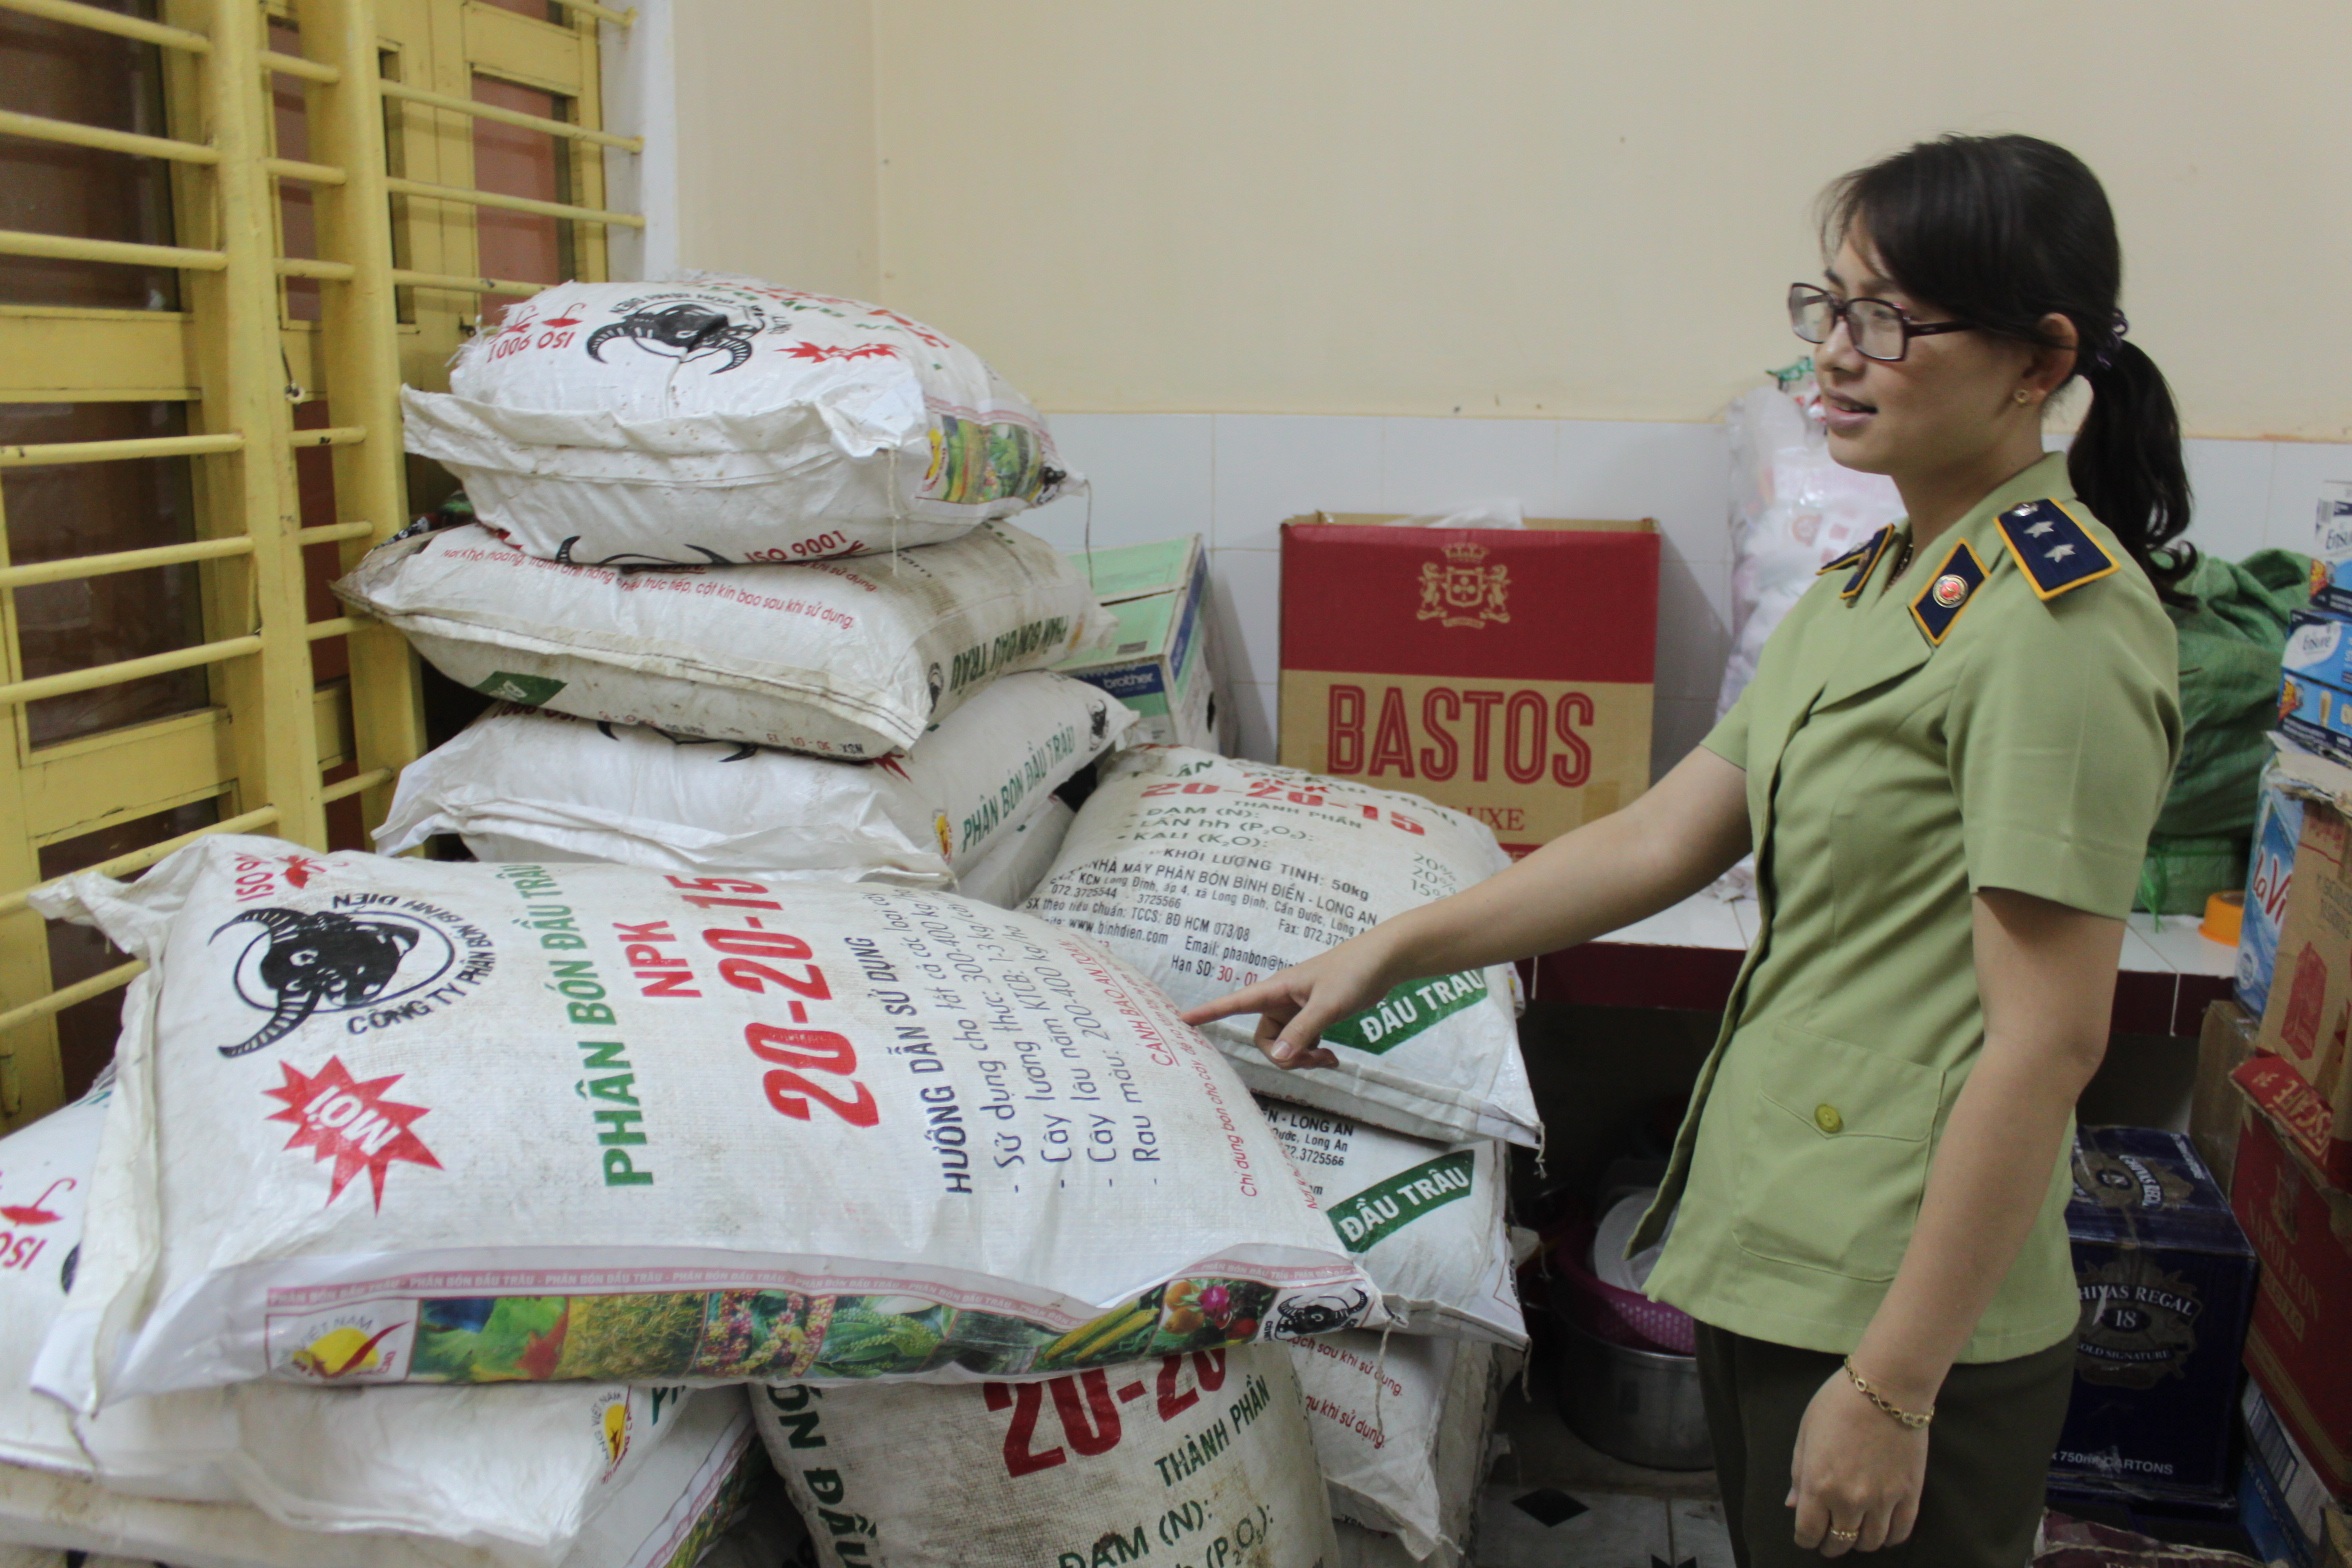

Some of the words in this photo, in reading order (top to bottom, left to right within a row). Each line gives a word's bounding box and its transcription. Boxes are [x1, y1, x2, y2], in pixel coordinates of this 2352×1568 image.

[485, 333, 532, 363] 9001
[538, 331, 576, 350] ISO
[790, 530, 849, 557] 9001
[736, 588, 762, 607] bao
[762, 596, 785, 611] sau
[786, 598, 805, 614] khi
[1103, 672, 1154, 690] brother
[1327, 684, 1595, 788] BASTOS
[960, 794, 999, 853] PHÂN
[1140, 782, 1426, 836] 20-20-15
[1133, 831, 1188, 842] KALI
[495, 864, 563, 900] TRÂU
[1155, 860, 1196, 882] PHÂN
[1198, 869, 1230, 888] BÓN
[1316, 896, 1355, 920] LONG
[1357, 910, 1378, 927] AN
[1211, 850, 1273, 872] LƯỢNG
[1331, 878, 1370, 903] 50kg
[1211, 890, 1238, 907] Long
[512, 904, 589, 951] ĐẦU
[1050, 884, 1118, 899] 072.3725544
[1136, 893, 1182, 909] 3725566
[1277, 918, 1300, 936] Fax:
[1131, 906, 1162, 924] TCCS:
[1184, 915, 1210, 933] HCM
[1213, 921, 1251, 943] 073/08
[611, 919, 703, 999] NPK
[843, 936, 900, 983] DỤNG
[900, 936, 932, 958] các
[920, 920, 992, 984] 300-400
[976, 943, 1014, 962] 1-3
[1068, 918, 1169, 946] www.binhdien.com
[1184, 935, 1221, 958] Email:
[1002, 969, 1051, 1011] KTCB:
[1170, 954, 1192, 974] Hạn
[1216, 965, 1234, 983] 30
[346, 999, 435, 1036] CÔNG
[425, 982, 468, 1006] TY
[455, 951, 497, 987] PHÂN
[544, 960, 617, 1026] BÓN
[663, 873, 881, 1128] 20-20-15
[866, 988, 918, 1017] SỬ
[1033, 965, 1112, 1042] 200-400
[887, 1026, 944, 1076] DẪN
[952, 1018, 989, 1051] cho
[1042, 1017, 1081, 1059] năm
[978, 1060, 1017, 1121] dụng
[1014, 1041, 1056, 1101] lương
[1070, 1068, 1101, 1101] lâu
[1105, 1049, 1144, 1104] màu:
[1203, 1081, 1224, 1107] cho
[302, 1084, 402, 1158] MỚI
[573, 1040, 654, 1187] PHÂN
[1290, 1115, 1331, 1135] LONG
[1333, 1122, 1354, 1138] AN
[919, 1085, 973, 1194] HƯỚNG
[1041, 1113, 1073, 1163] Cây
[1087, 1113, 1117, 1163] Cây
[1131, 1114, 1161, 1162] Rau
[1304, 1135, 1330, 1151] Long
[1334, 1140, 1348, 1153] An
[1337, 1194, 1401, 1244] ĐẦU
[1396, 1166, 1471, 1207] TRÂU
[2078, 1284, 2130, 1301] HIVAS
[2134, 1286, 2193, 1317] REGAL
[2115, 1309, 2137, 1329] 18
[1316, 1342, 1340, 1360] sau
[1339, 1349, 1359, 1368] khi
[2105, 1349, 2171, 1361] SIGNATURE
[766, 1384, 828, 1449] ÓN
[1320, 1398, 1341, 1421] khi
[1338, 1408, 1358, 1429] sử
[1354, 1419, 1387, 1450] dụng.
[1153, 1417, 1231, 1488] THÀNH
[2103, 1455, 2174, 1476] CARTONS
[1157, 1498, 1214, 1548] (N):
